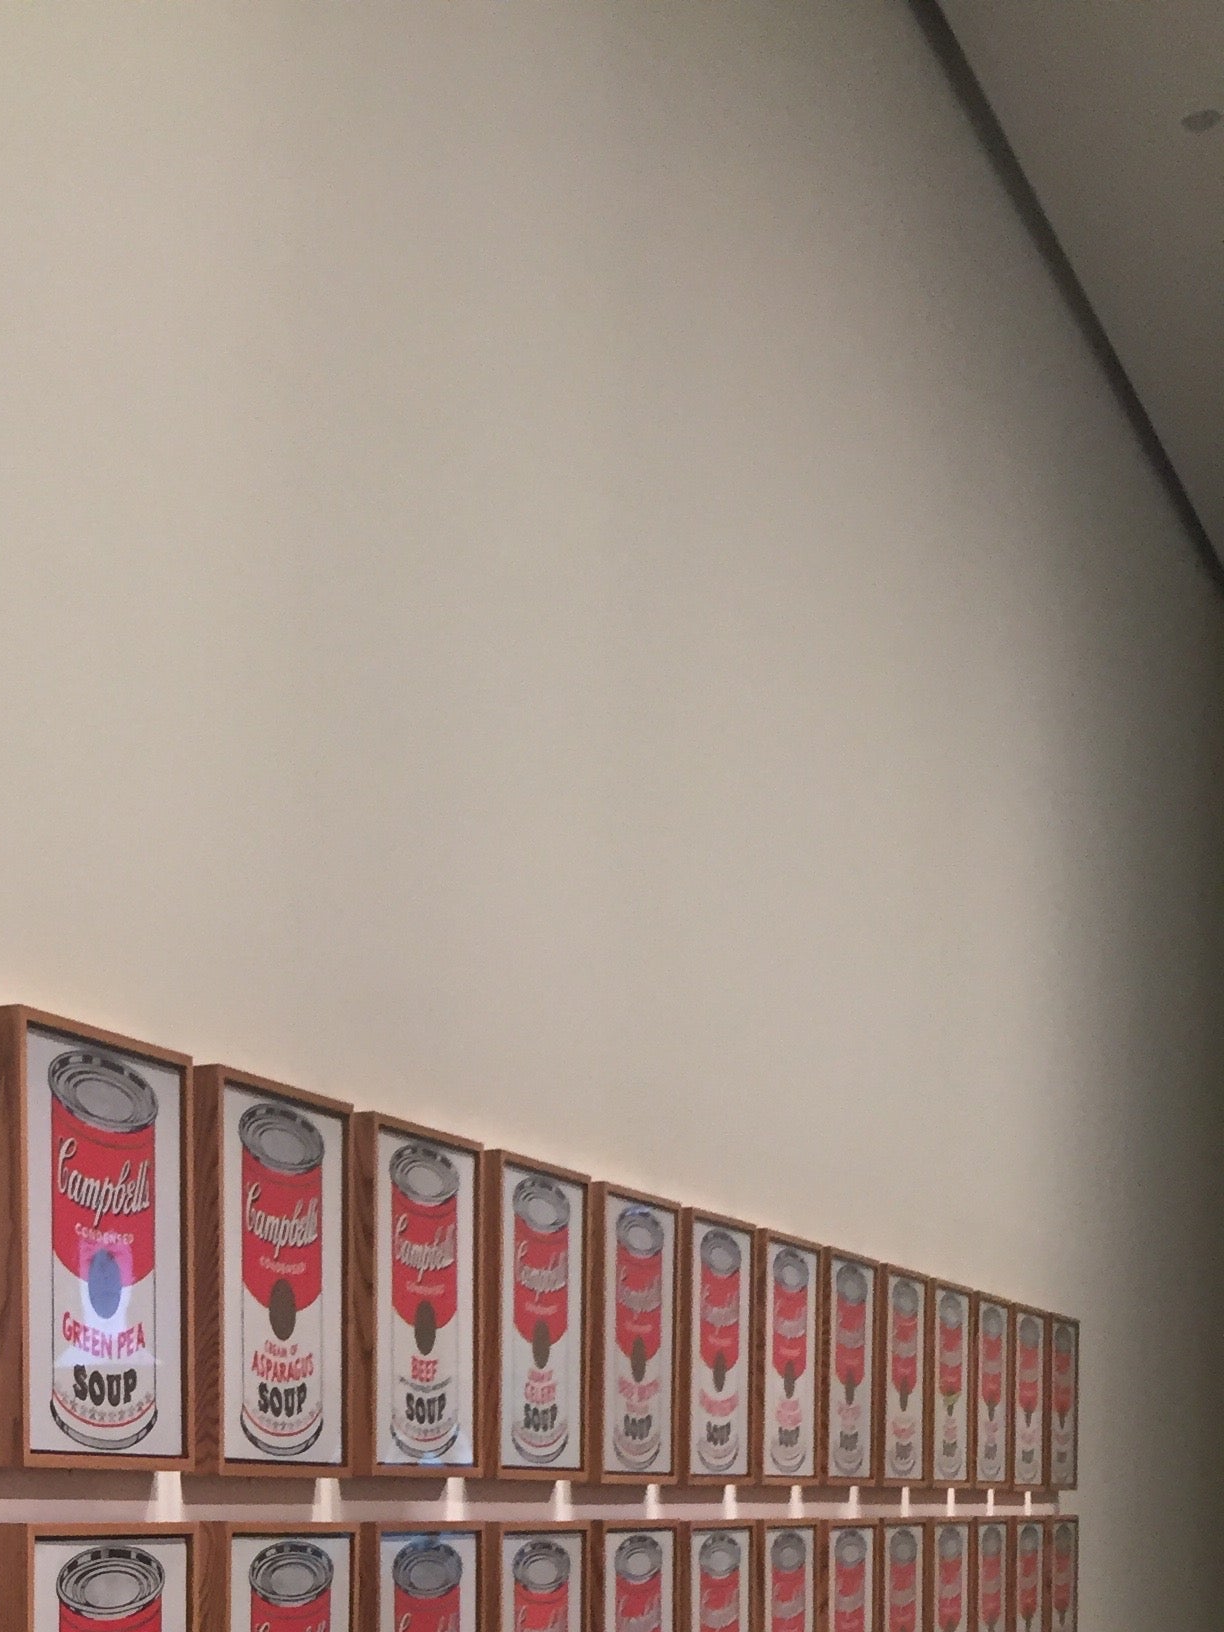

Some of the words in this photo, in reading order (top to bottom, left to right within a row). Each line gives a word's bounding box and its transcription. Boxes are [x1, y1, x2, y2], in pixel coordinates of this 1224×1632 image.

[62, 1311, 113, 1360] GREEN
[116, 1322, 146, 1360] PEA
[251, 1350, 314, 1383] ASPARAGUS
[73, 1364, 137, 1407] SOUP
[258, 1381, 307, 1418] SOUP
[405, 1392, 447, 1424] SOUP
